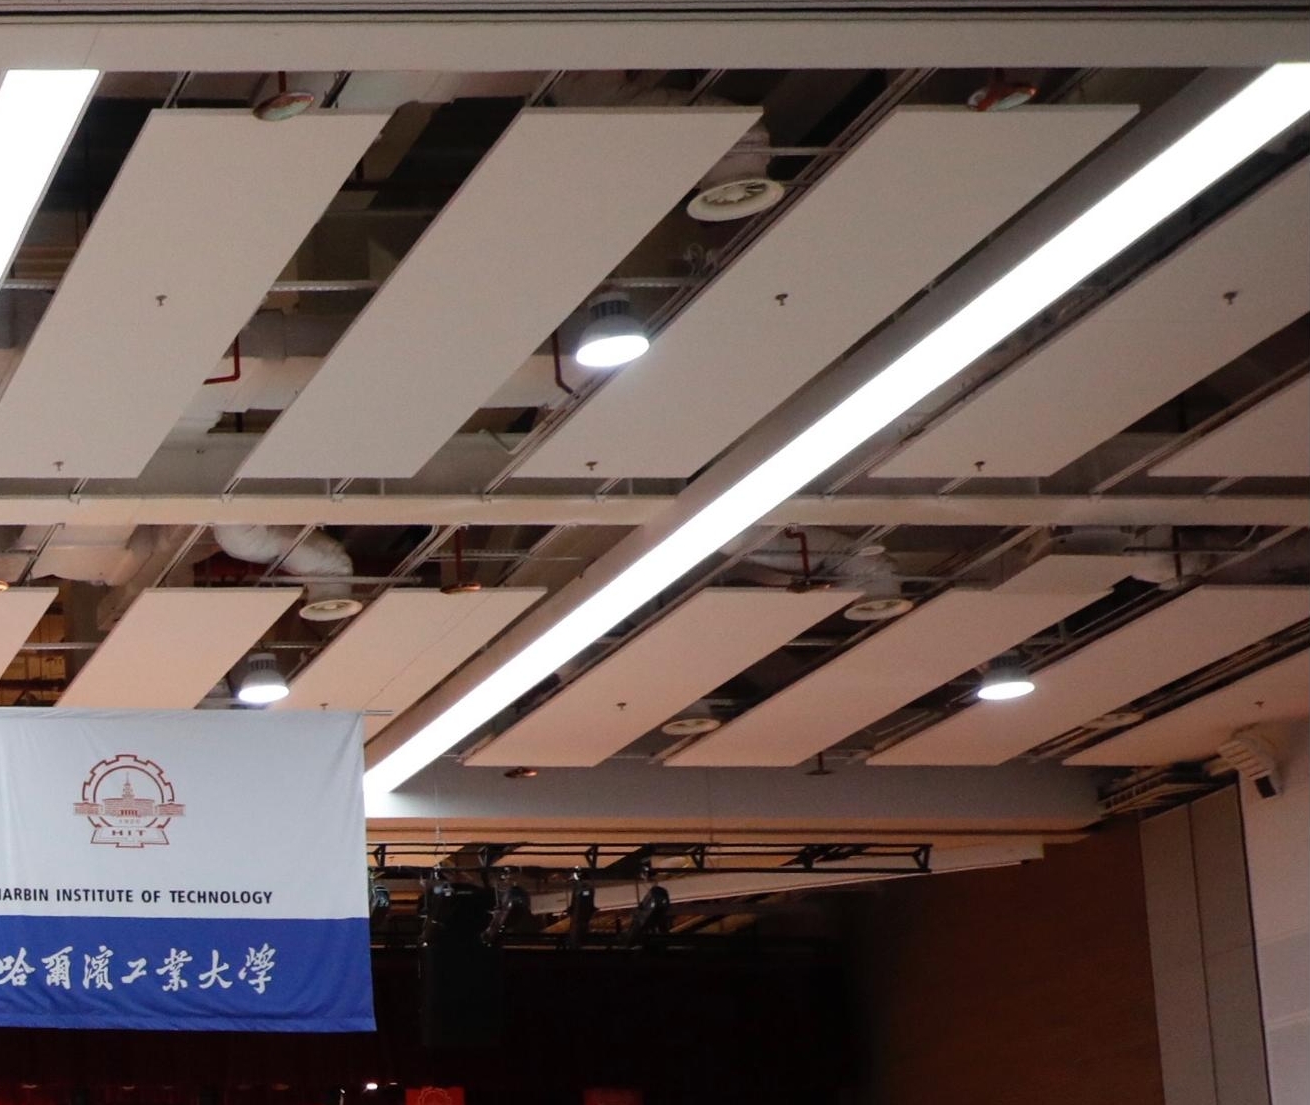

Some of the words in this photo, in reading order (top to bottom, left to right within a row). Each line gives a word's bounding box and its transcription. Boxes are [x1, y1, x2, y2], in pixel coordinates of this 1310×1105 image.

[56, 888, 133, 902] INSTITUTE
[141, 889, 161, 903] OF
[169, 890, 273, 904] TECHNOLOGY
